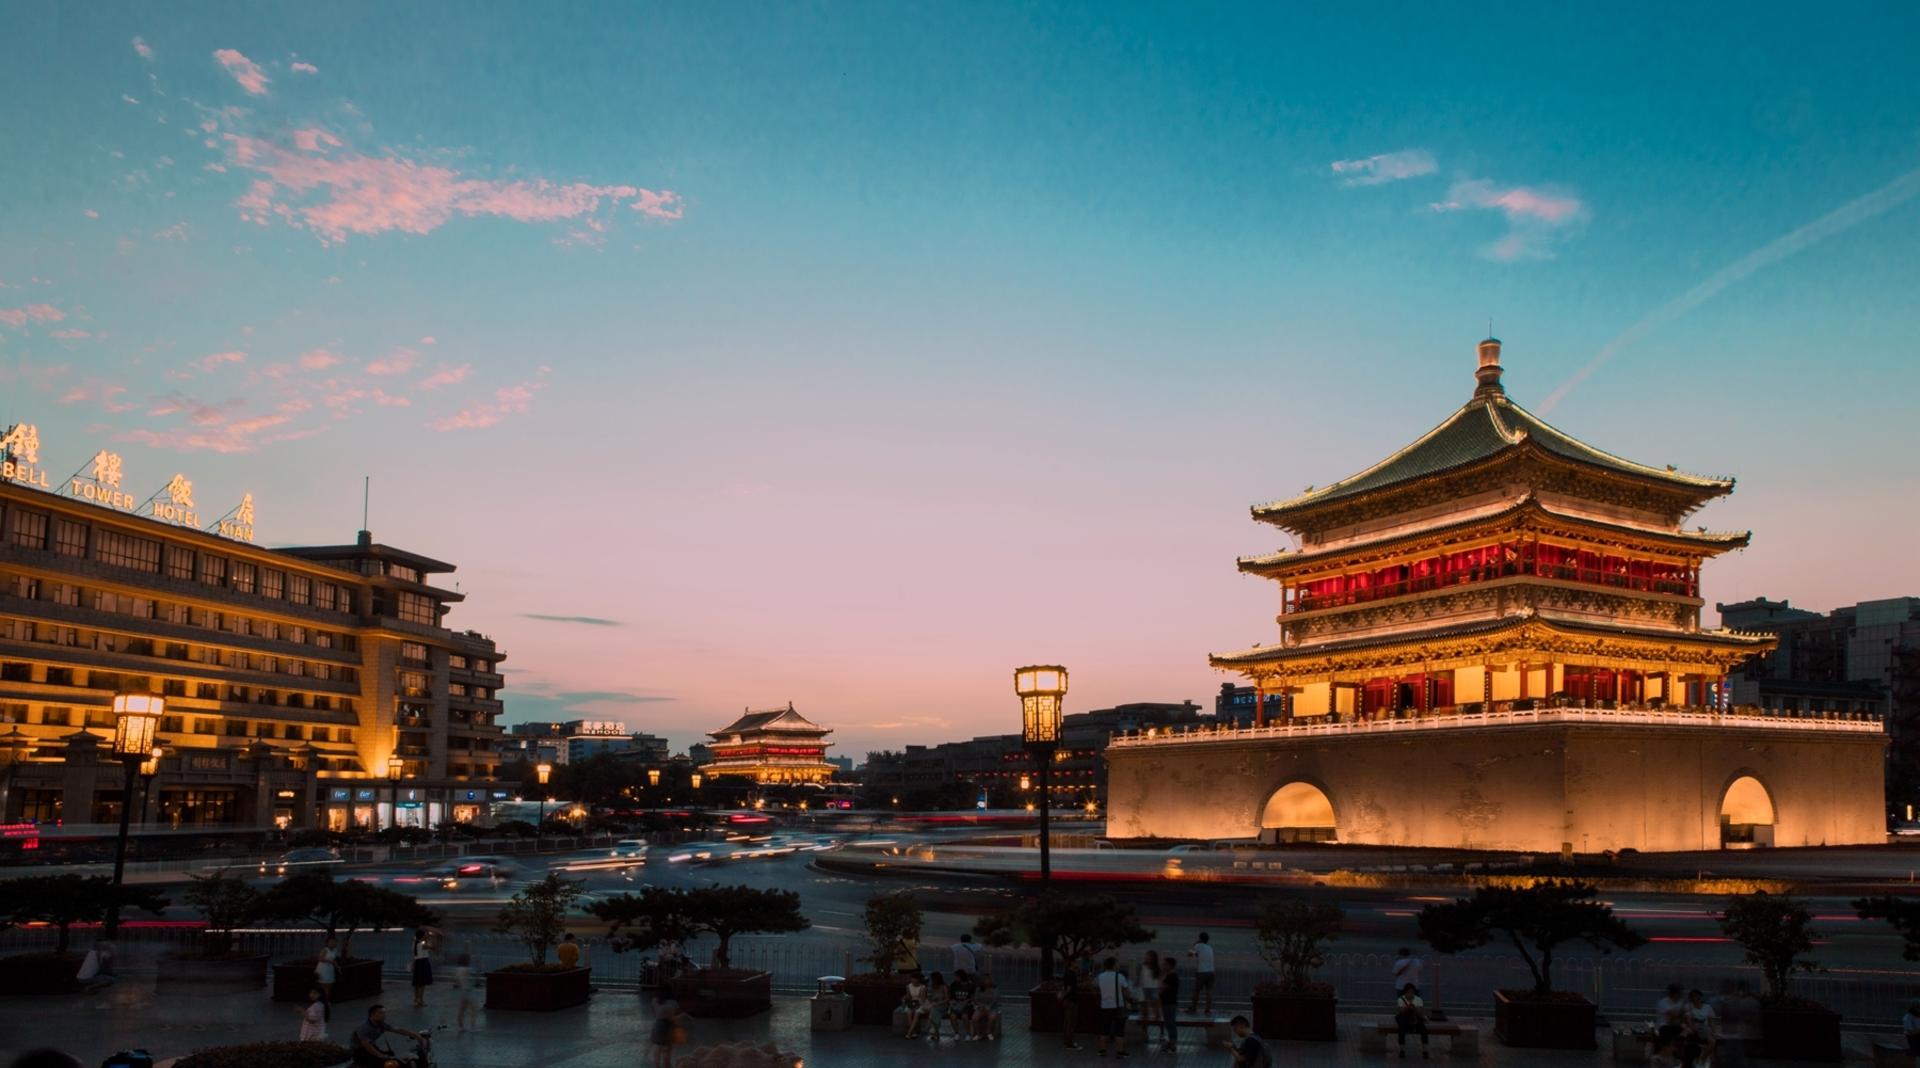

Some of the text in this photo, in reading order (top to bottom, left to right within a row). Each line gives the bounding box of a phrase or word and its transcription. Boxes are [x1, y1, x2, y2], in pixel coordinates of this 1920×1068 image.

[3, 461, 254, 542] BELL TOWER HOTEL XIAN
